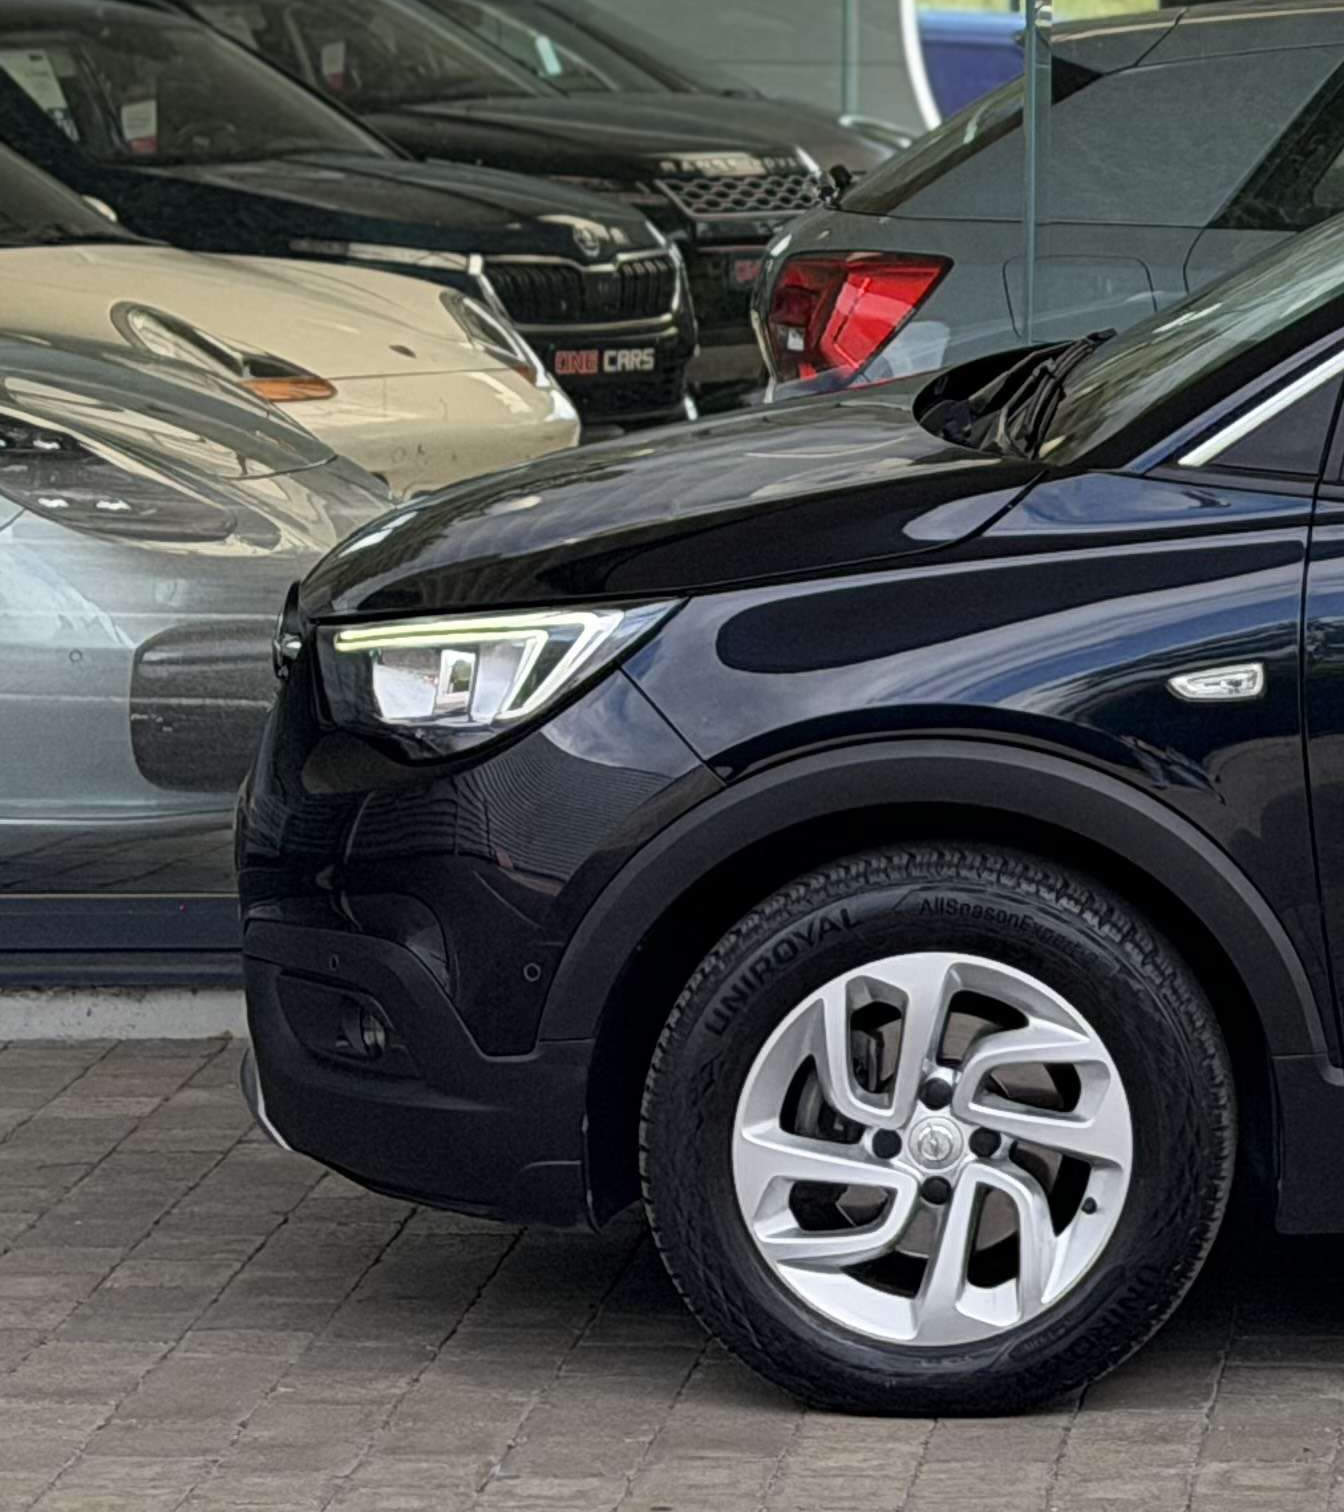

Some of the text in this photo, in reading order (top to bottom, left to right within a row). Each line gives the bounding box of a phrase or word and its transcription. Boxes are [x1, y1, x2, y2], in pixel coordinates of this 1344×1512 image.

[554, 348, 655, 374] ONE CARS
[706, 907, 864, 1037] UNIROYAL
